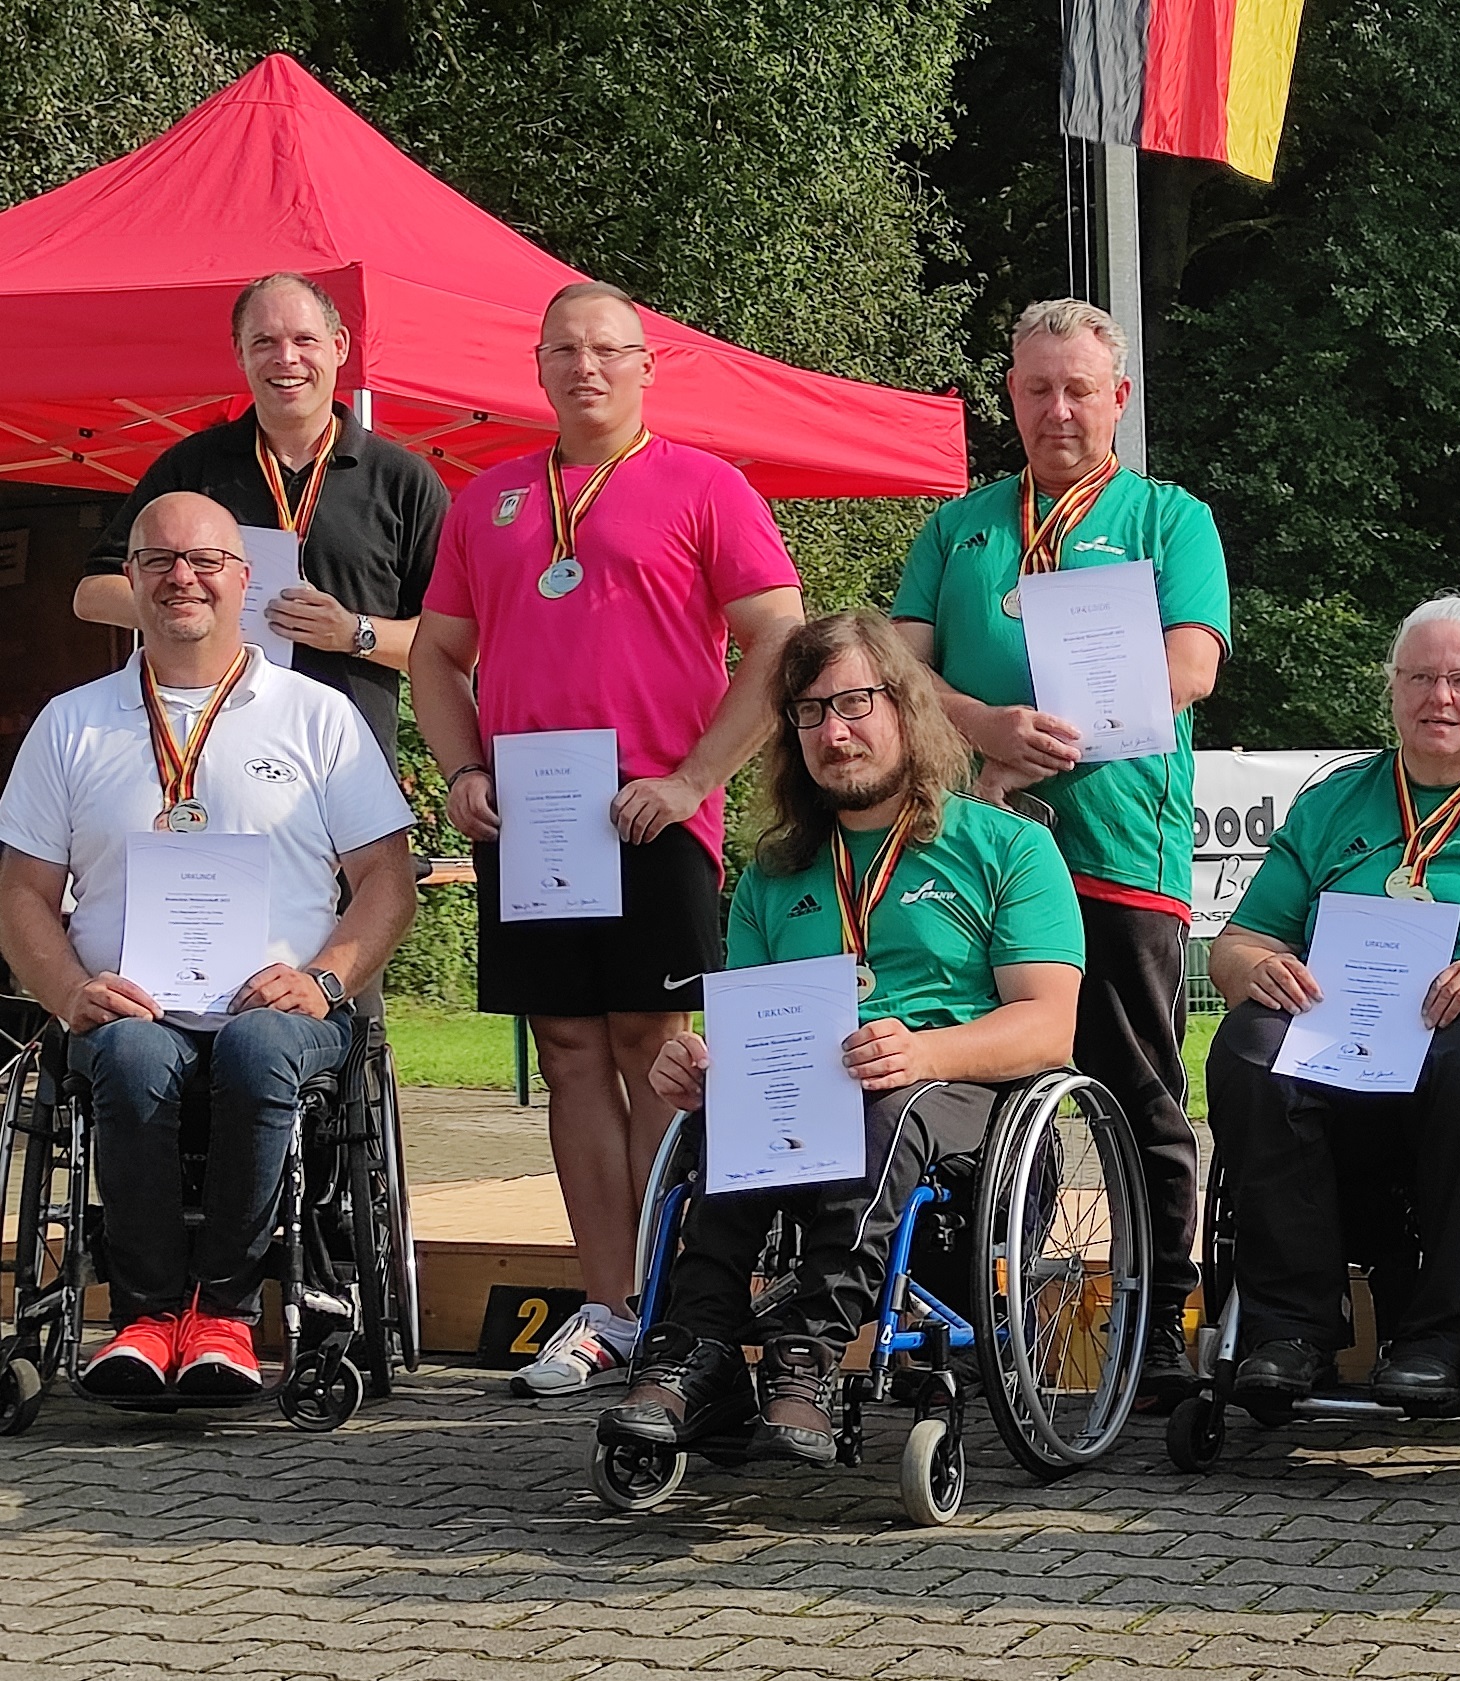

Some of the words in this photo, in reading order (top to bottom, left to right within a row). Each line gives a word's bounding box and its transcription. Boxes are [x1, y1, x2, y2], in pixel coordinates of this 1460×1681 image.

[534, 767, 571, 777] URKUNDE
[181, 873, 217, 881] URKUNDE
[1365, 940, 1400, 950] URKUNDE
[757, 1005, 804, 1019] URKUNDE
[510, 1298, 549, 1354] 2
